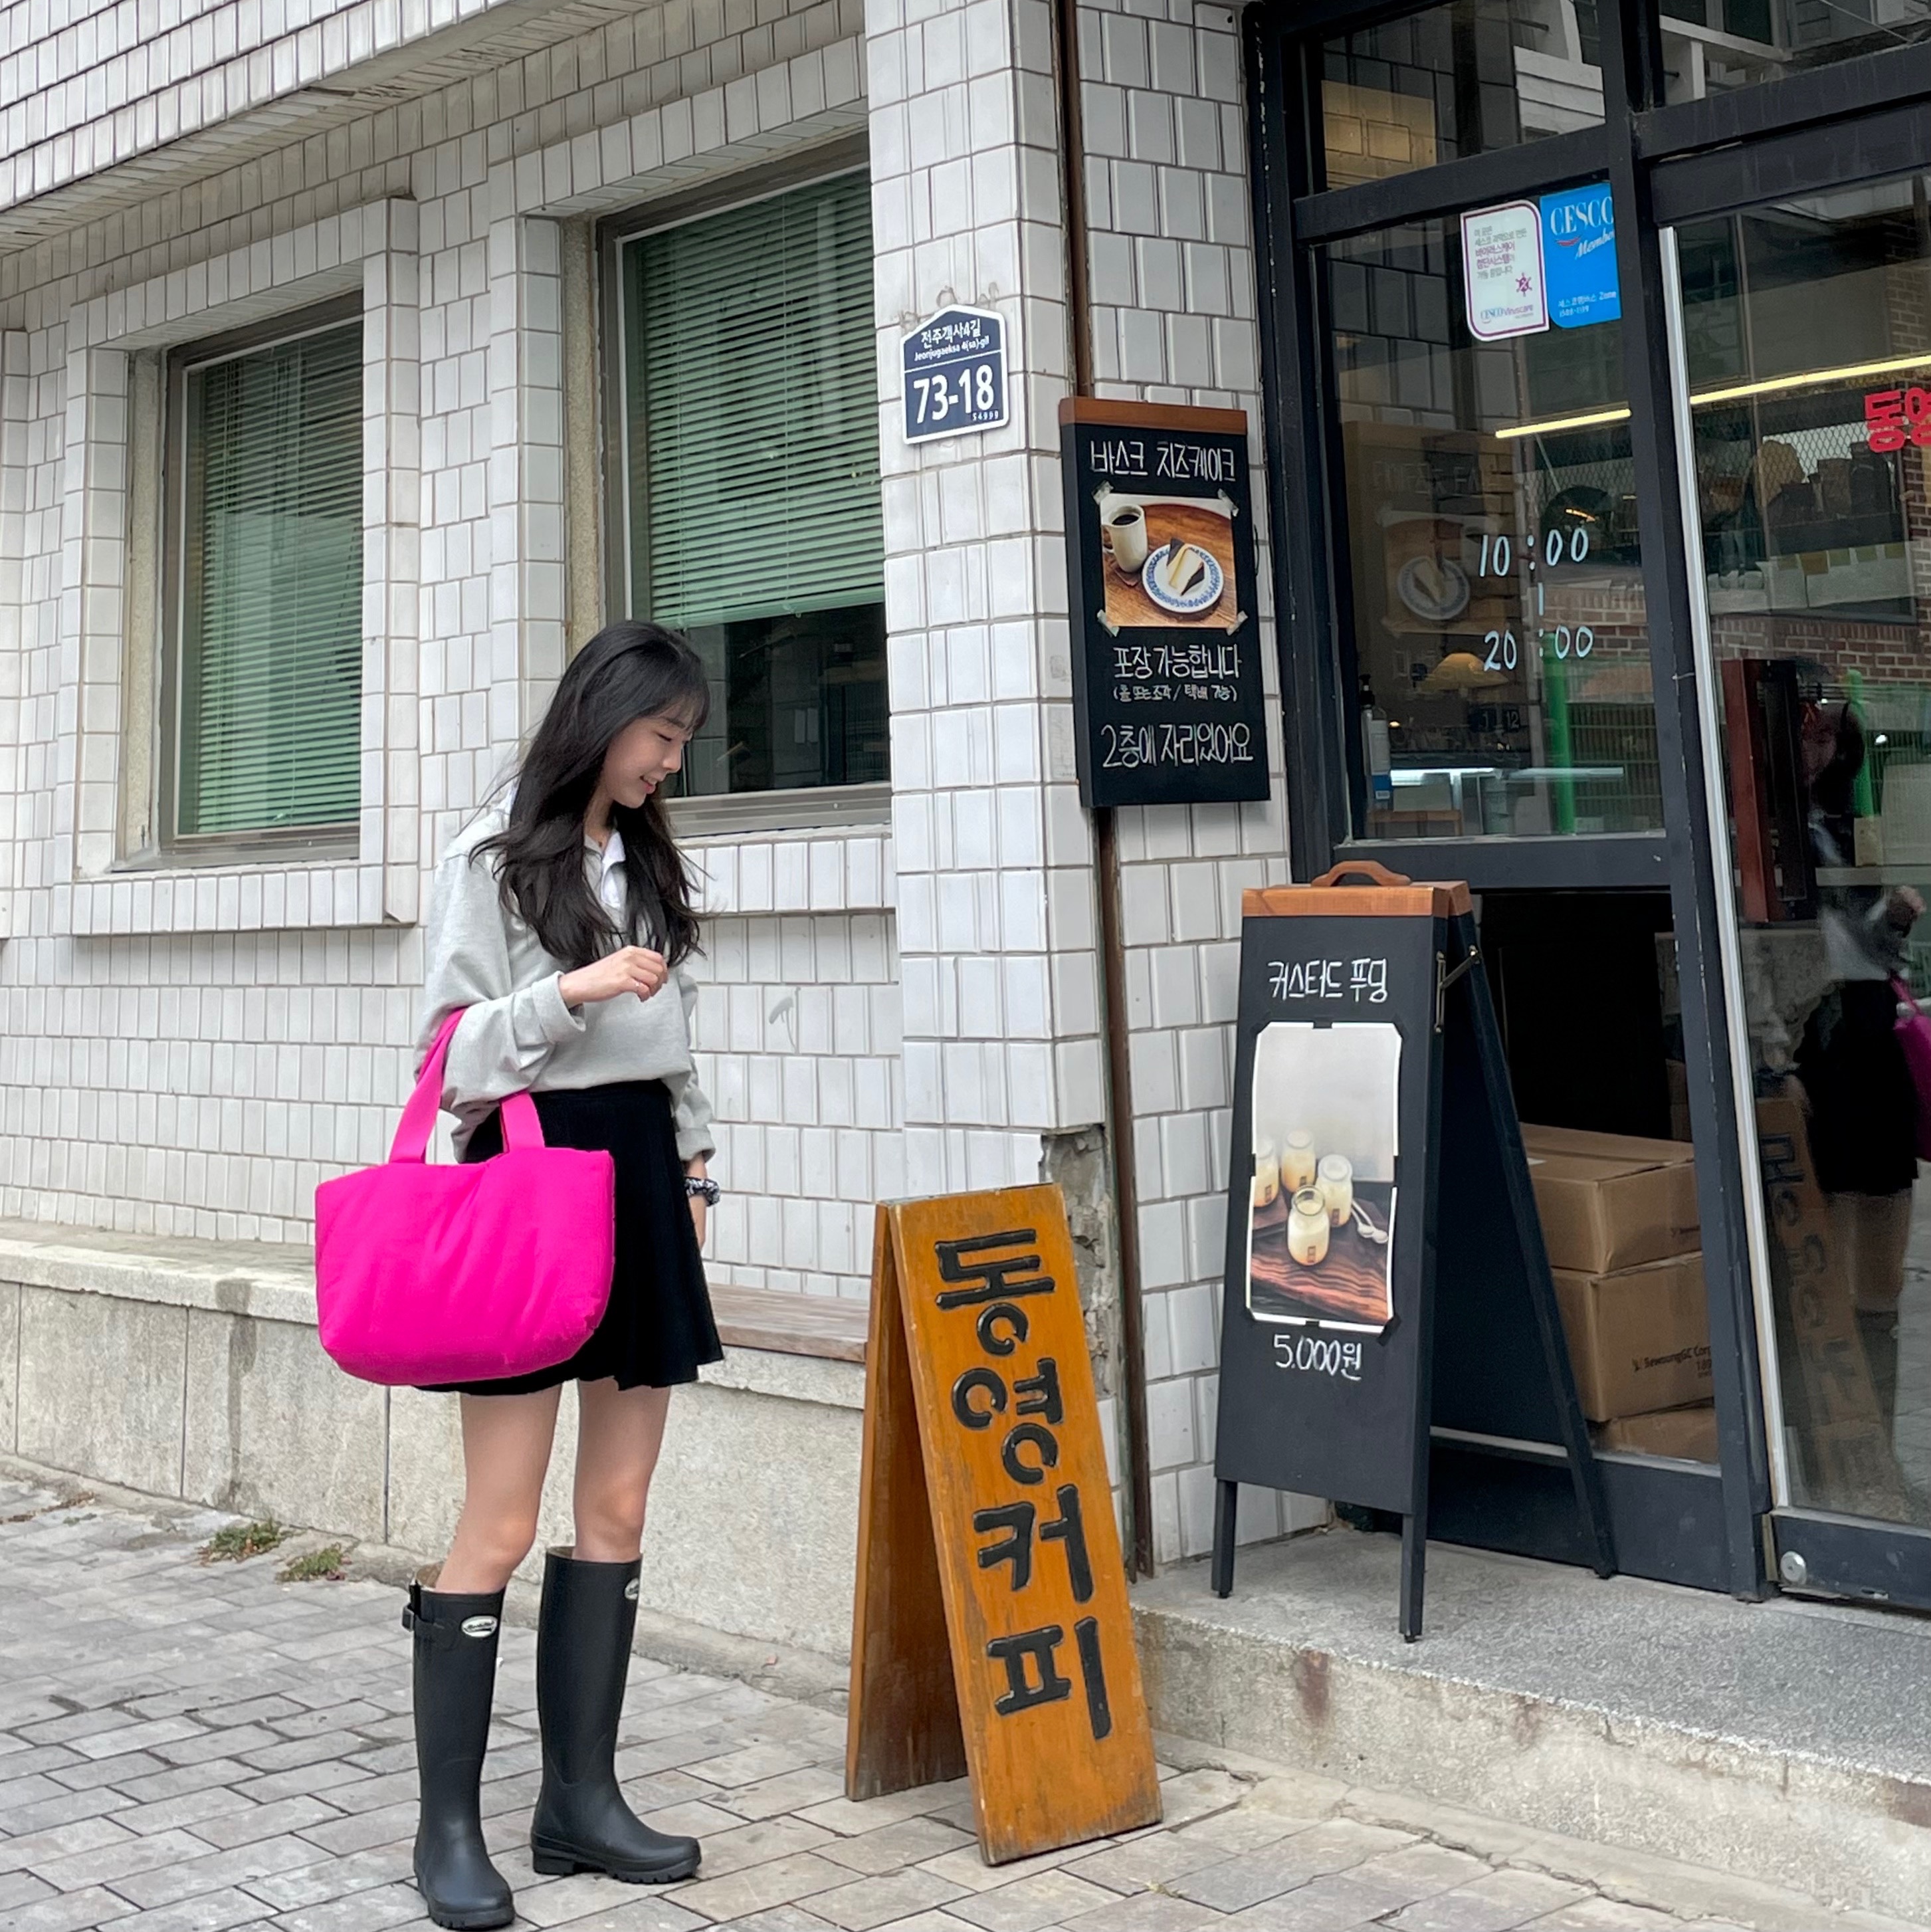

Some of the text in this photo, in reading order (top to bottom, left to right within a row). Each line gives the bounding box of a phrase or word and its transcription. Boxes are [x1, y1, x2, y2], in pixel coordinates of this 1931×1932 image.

[921, 318, 981, 349] 전주객사4길
[913, 364, 994, 424] 73-18
[1090, 440, 1236, 482] 바스크 치즈케이크
[1478, 527, 1589, 577] 10:00
[1484, 625, 1593, 671] 20:00
[1267, 958, 1388, 1003] 커스터드 푸딩
